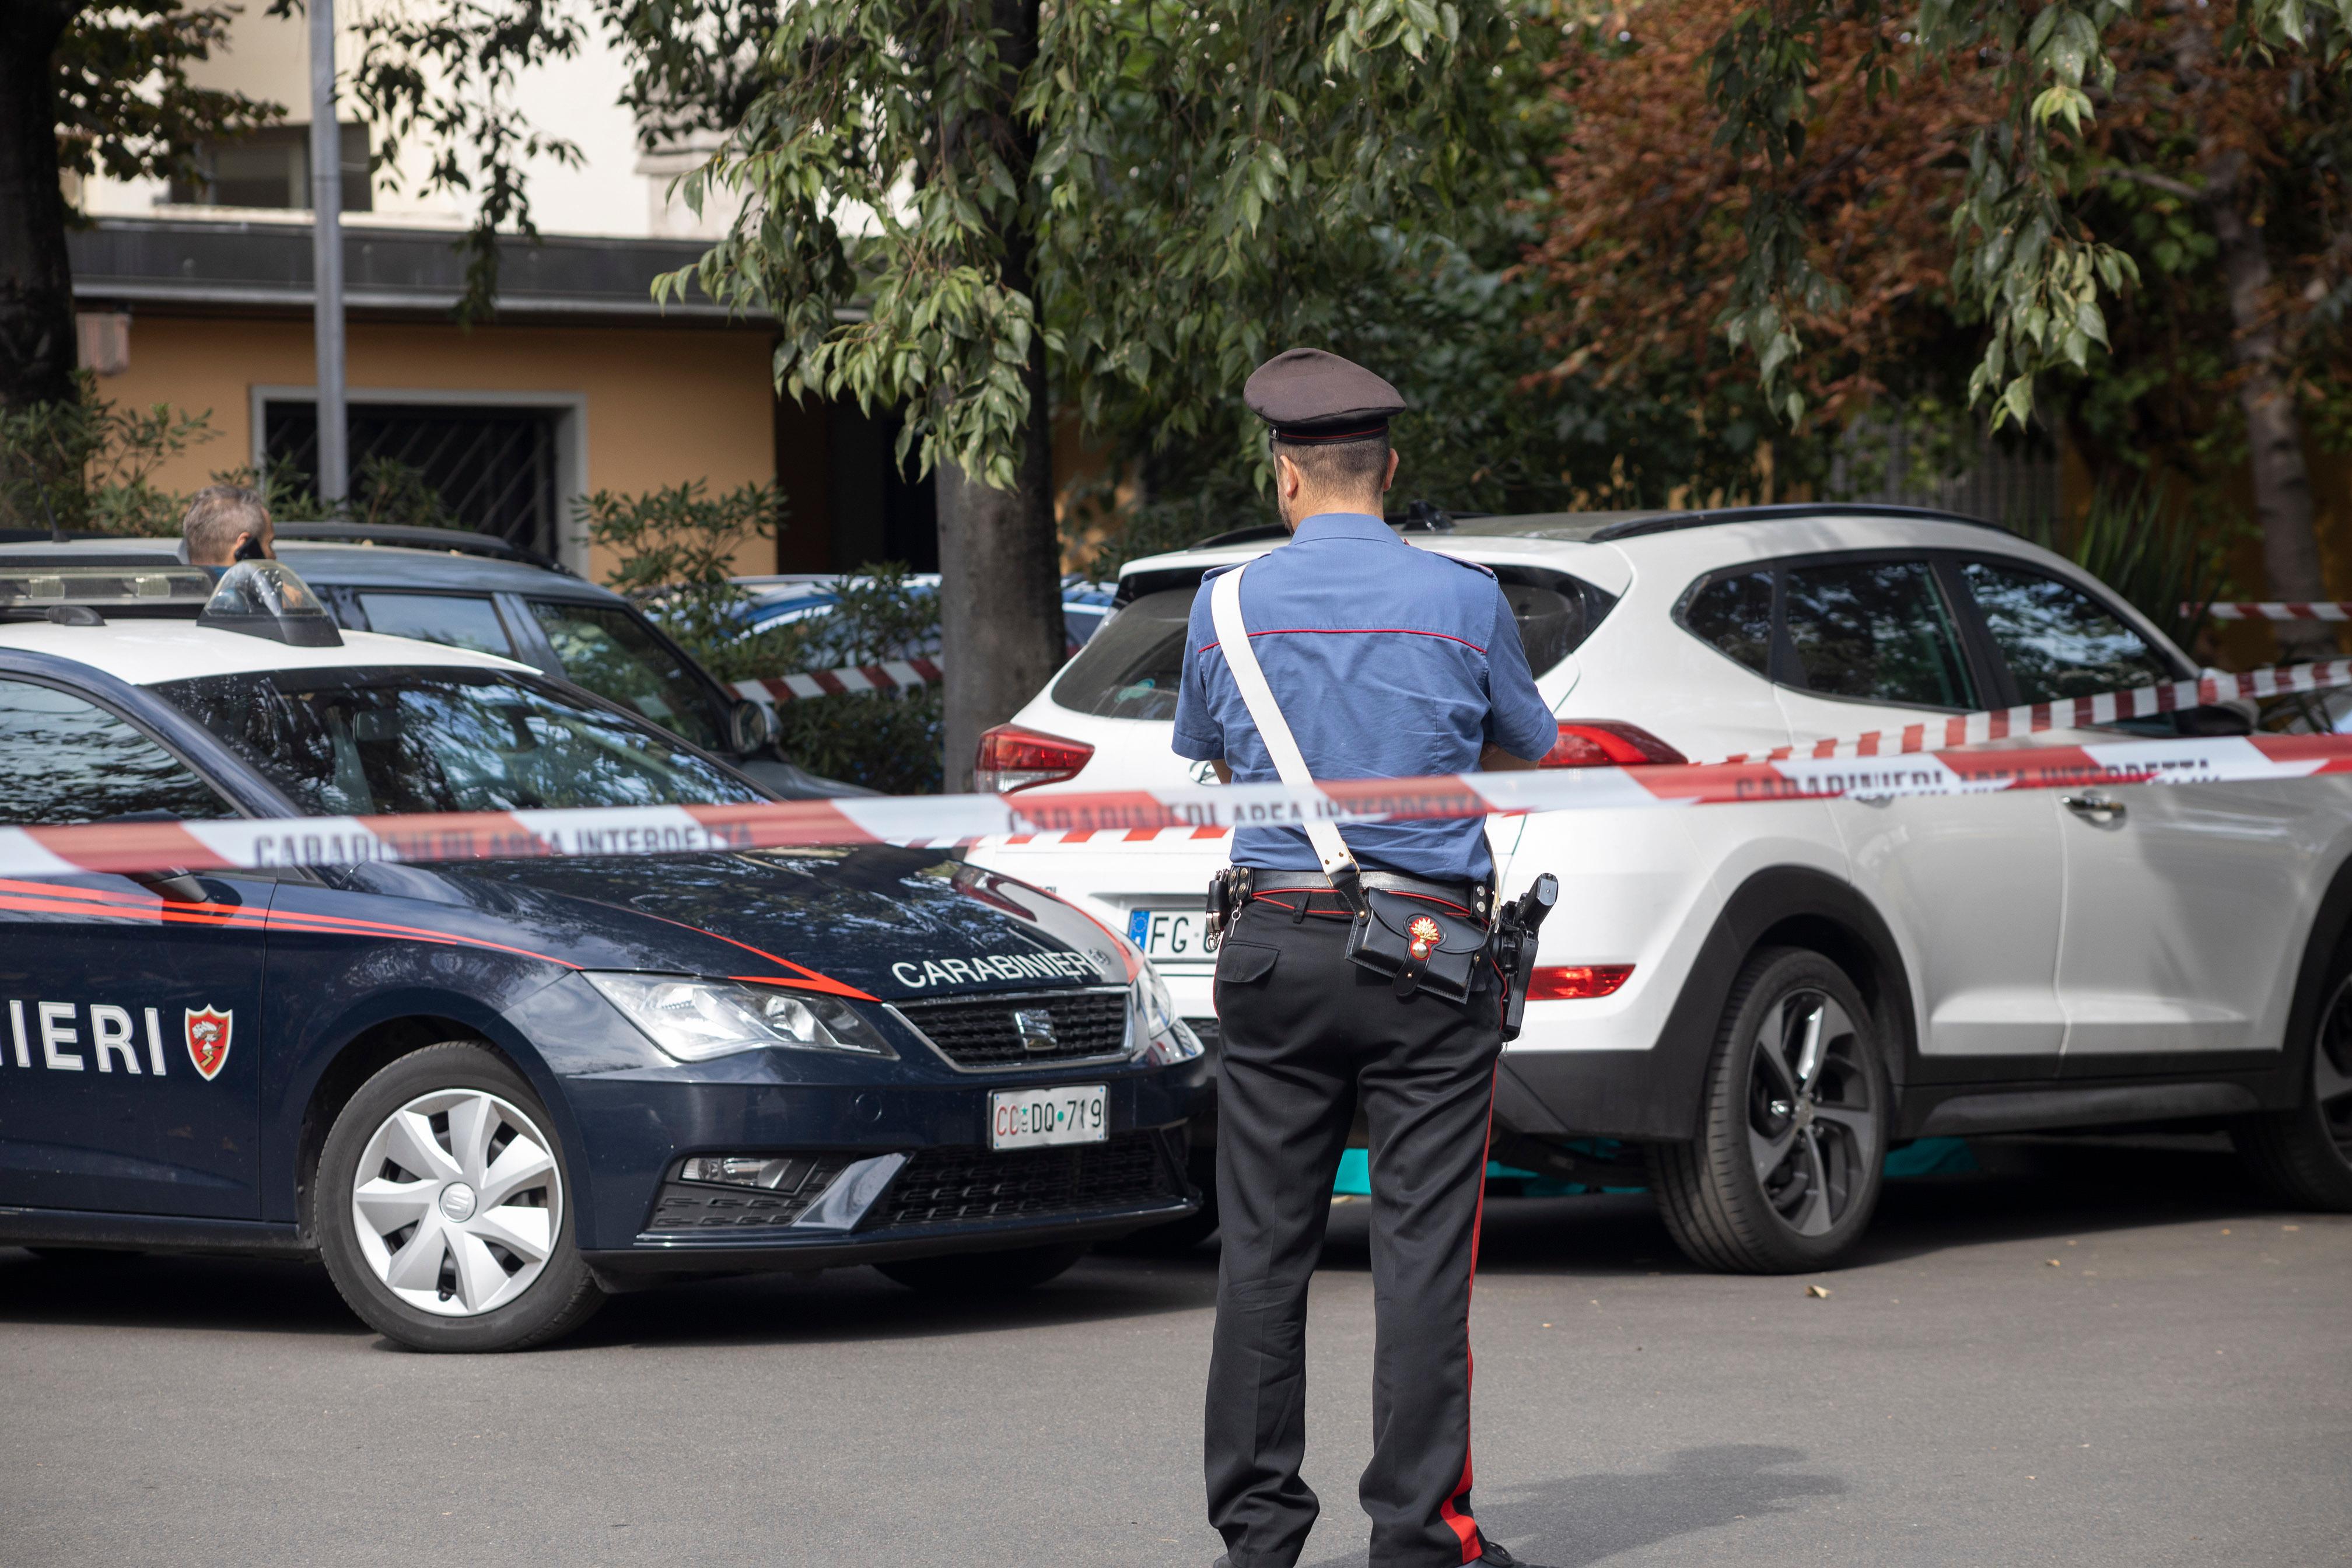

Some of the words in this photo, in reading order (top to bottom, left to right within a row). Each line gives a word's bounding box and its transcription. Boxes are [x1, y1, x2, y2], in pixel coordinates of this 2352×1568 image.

[891, 951, 1106, 988] CARABINIERI
[0, 999, 166, 1076] IERI
[996, 1104, 1019, 1136] CC
[1032, 1102, 1055, 1133] DQ
[1066, 1098, 1102, 1131] 719
